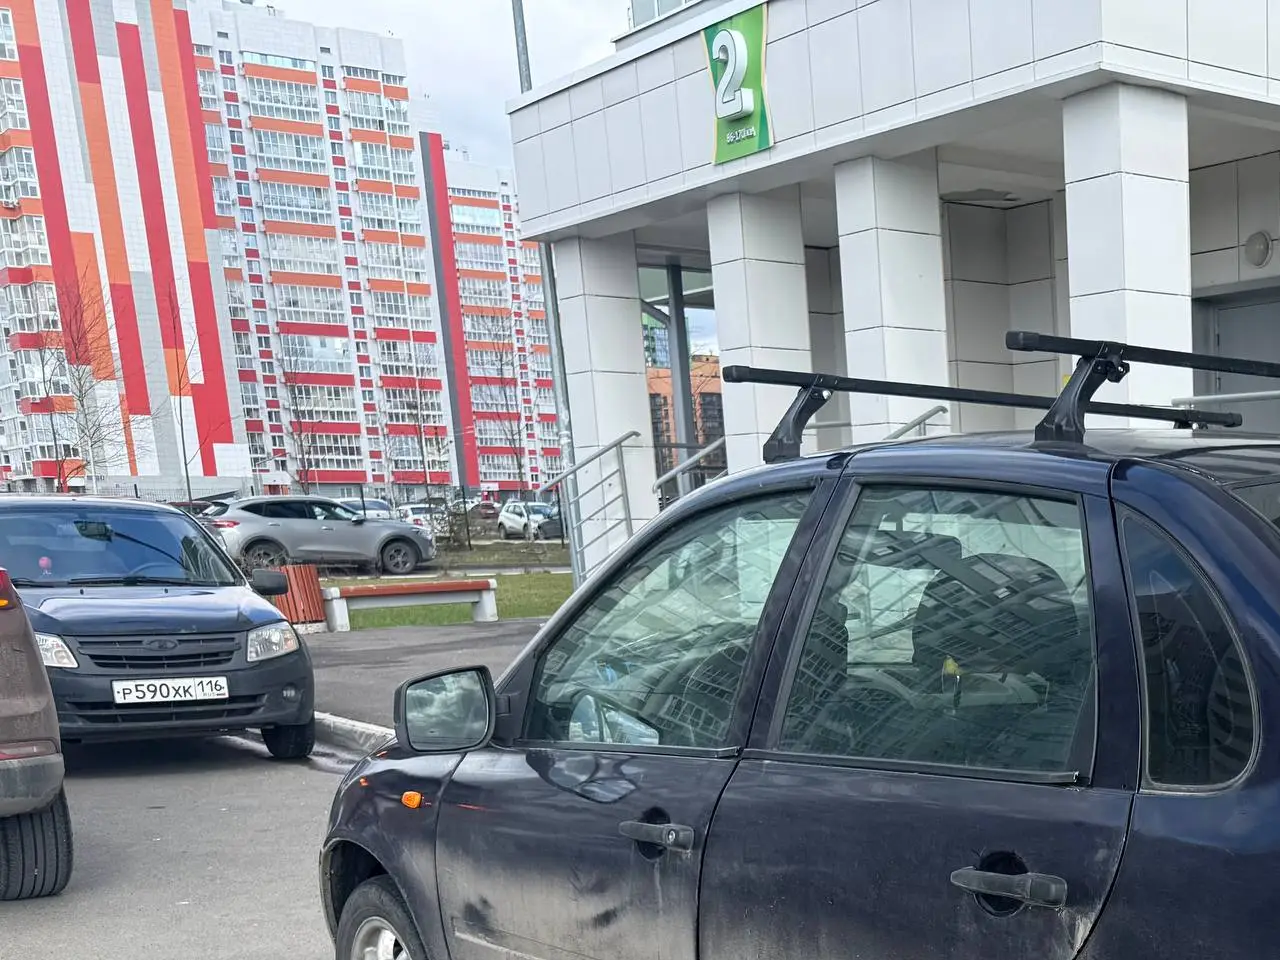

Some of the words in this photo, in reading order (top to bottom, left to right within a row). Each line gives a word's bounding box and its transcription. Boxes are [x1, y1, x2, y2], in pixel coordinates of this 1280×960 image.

[712, 28, 754, 121] 2
[122, 683, 193, 700] Р590ХК
[197, 680, 222, 692] 116
